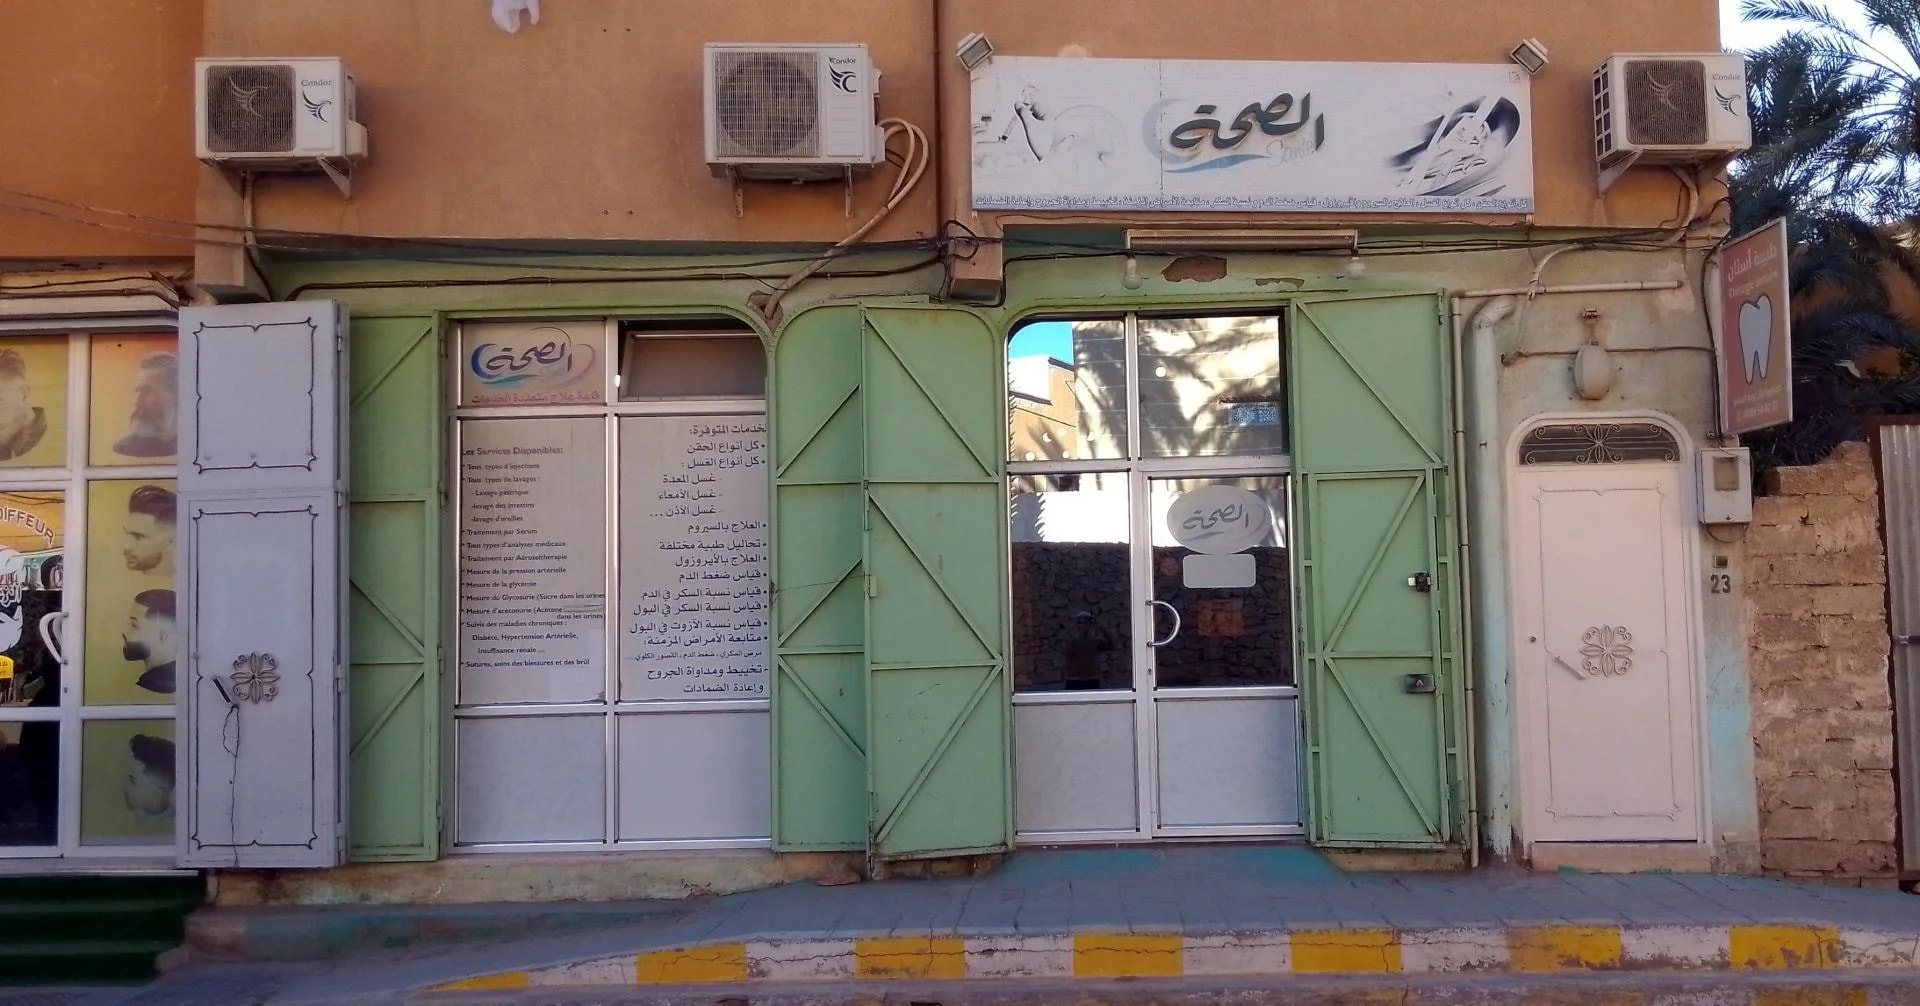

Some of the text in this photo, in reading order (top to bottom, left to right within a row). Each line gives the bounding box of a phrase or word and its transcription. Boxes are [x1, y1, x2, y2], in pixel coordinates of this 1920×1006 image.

[301, 79, 333, 87] Condor
[1712, 73, 1740, 81] Condor
[1170, 92, 1325, 151] الصحة
[486, 341, 572, 373] الصحة
[477, 447, 510, 455] Services
[687, 440, 760, 454] كل أنواع الحقن
[688, 456, 760, 470] كل أنواع الغسل
[662, 473, 717, 485] غسل المعدة
[658, 488, 718, 501] غسل الأمعاء
[692, 504, 718, 517] غسل
[1182, 503, 1249, 530] الصحة
[688, 520, 761, 534] العلاج بالسيروم
[659, 538, 761, 552] تحاليل طبية مختلفة
[504, 554, 514, 562] par
[731, 553, 761, 566] العلاج
[509, 568, 536, 576] pression
[679, 569, 761, 584] قياس ضغط الدم
[1710, 574, 1731, 594] 23
[502, 594, 536, 602] Glycosurie
[536, 592, 558, 601] (Sucre
[560, 592, 574, 600] dans
[642, 586, 762, 601] قياس نسبة السكر في الدم
[632, 600, 762, 617] قياس نسبة السكر في البول
[498, 620, 527, 628] maladies
[528, 620, 564, 628] chroniques
[629, 622, 656, 634] البول
[658, 621, 668, 635] في
[705, 619, 730, 631] نسبة
[733, 618, 762, 630] قياس
[501, 633, 544, 642] Hypertension
[684, 633, 725, 647] الأمراض
[728, 633, 762, 645] متابعة
[647, 664, 762, 680] تخييط ومداواة الجروح
[682, 682, 730, 693] الضمادات
